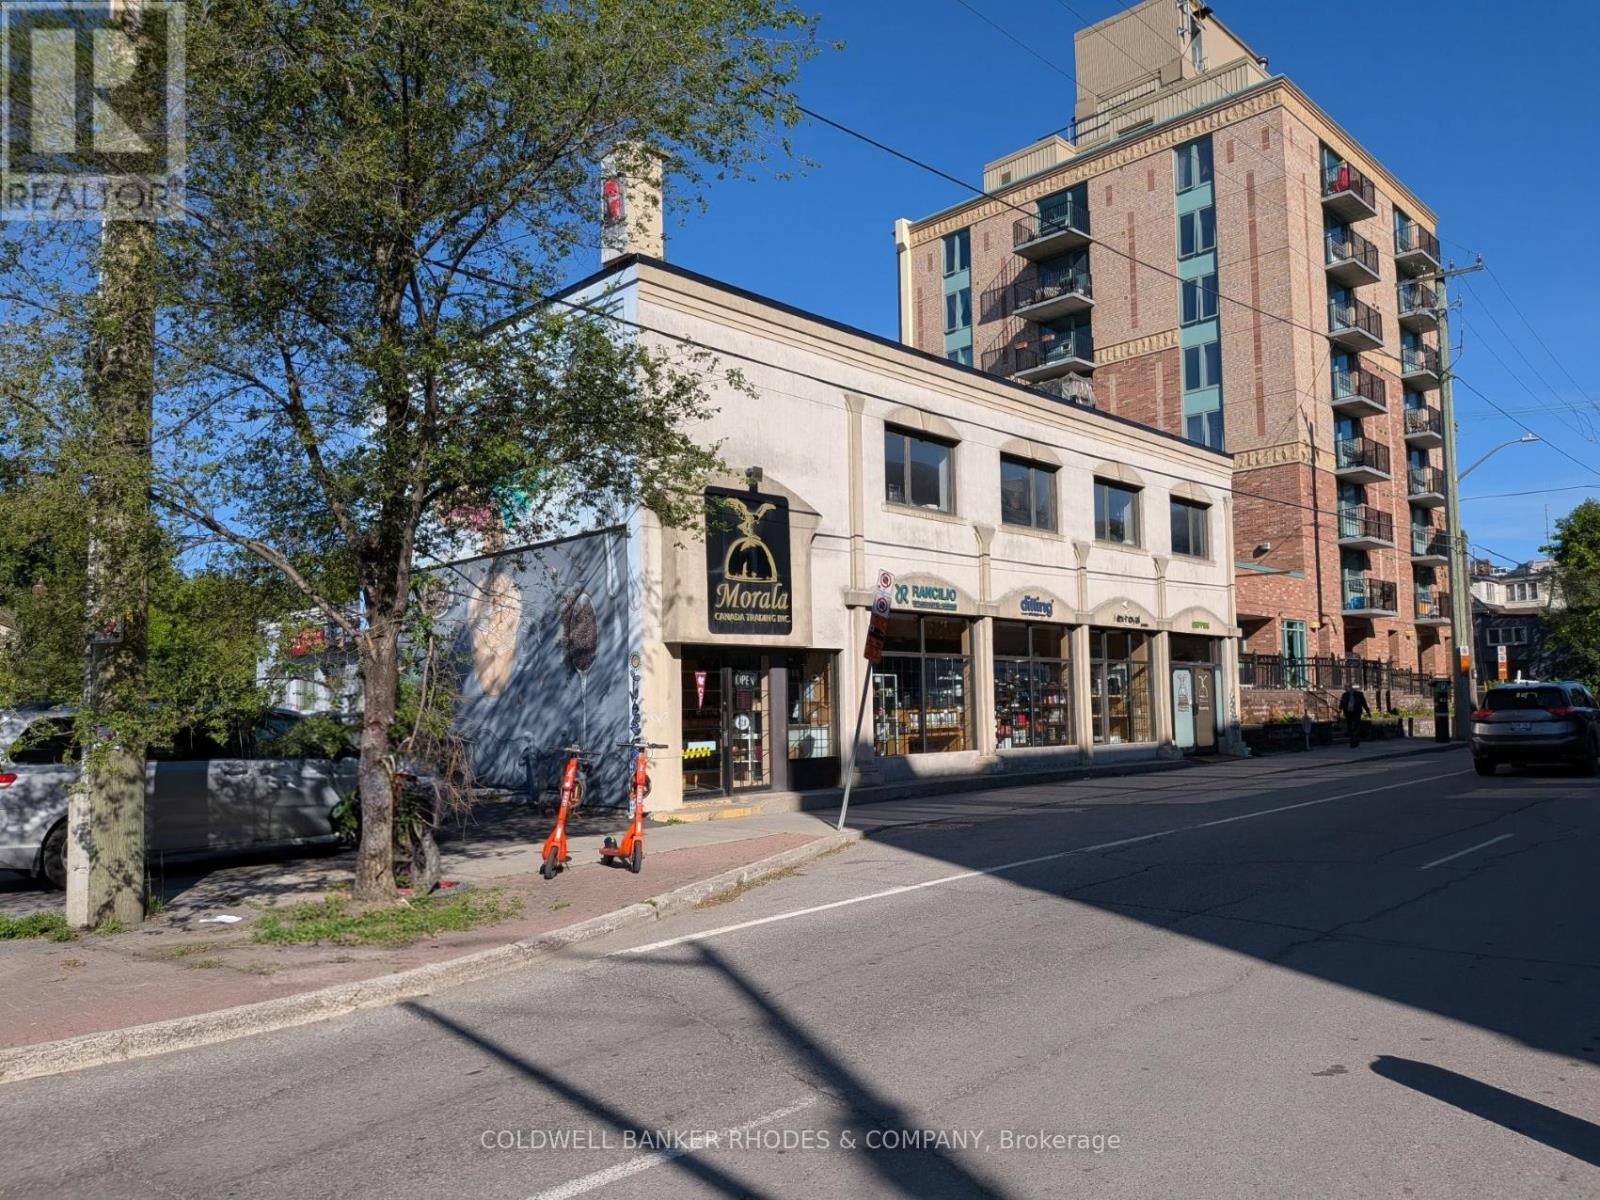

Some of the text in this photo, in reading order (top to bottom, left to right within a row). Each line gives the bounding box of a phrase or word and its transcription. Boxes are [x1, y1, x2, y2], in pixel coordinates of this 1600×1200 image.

[715, 583, 789, 610] Morala
[911, 585, 957, 602] RANCILIO
[714, 612, 744, 621] CANADA
[745, 613, 777, 623] TRADING
